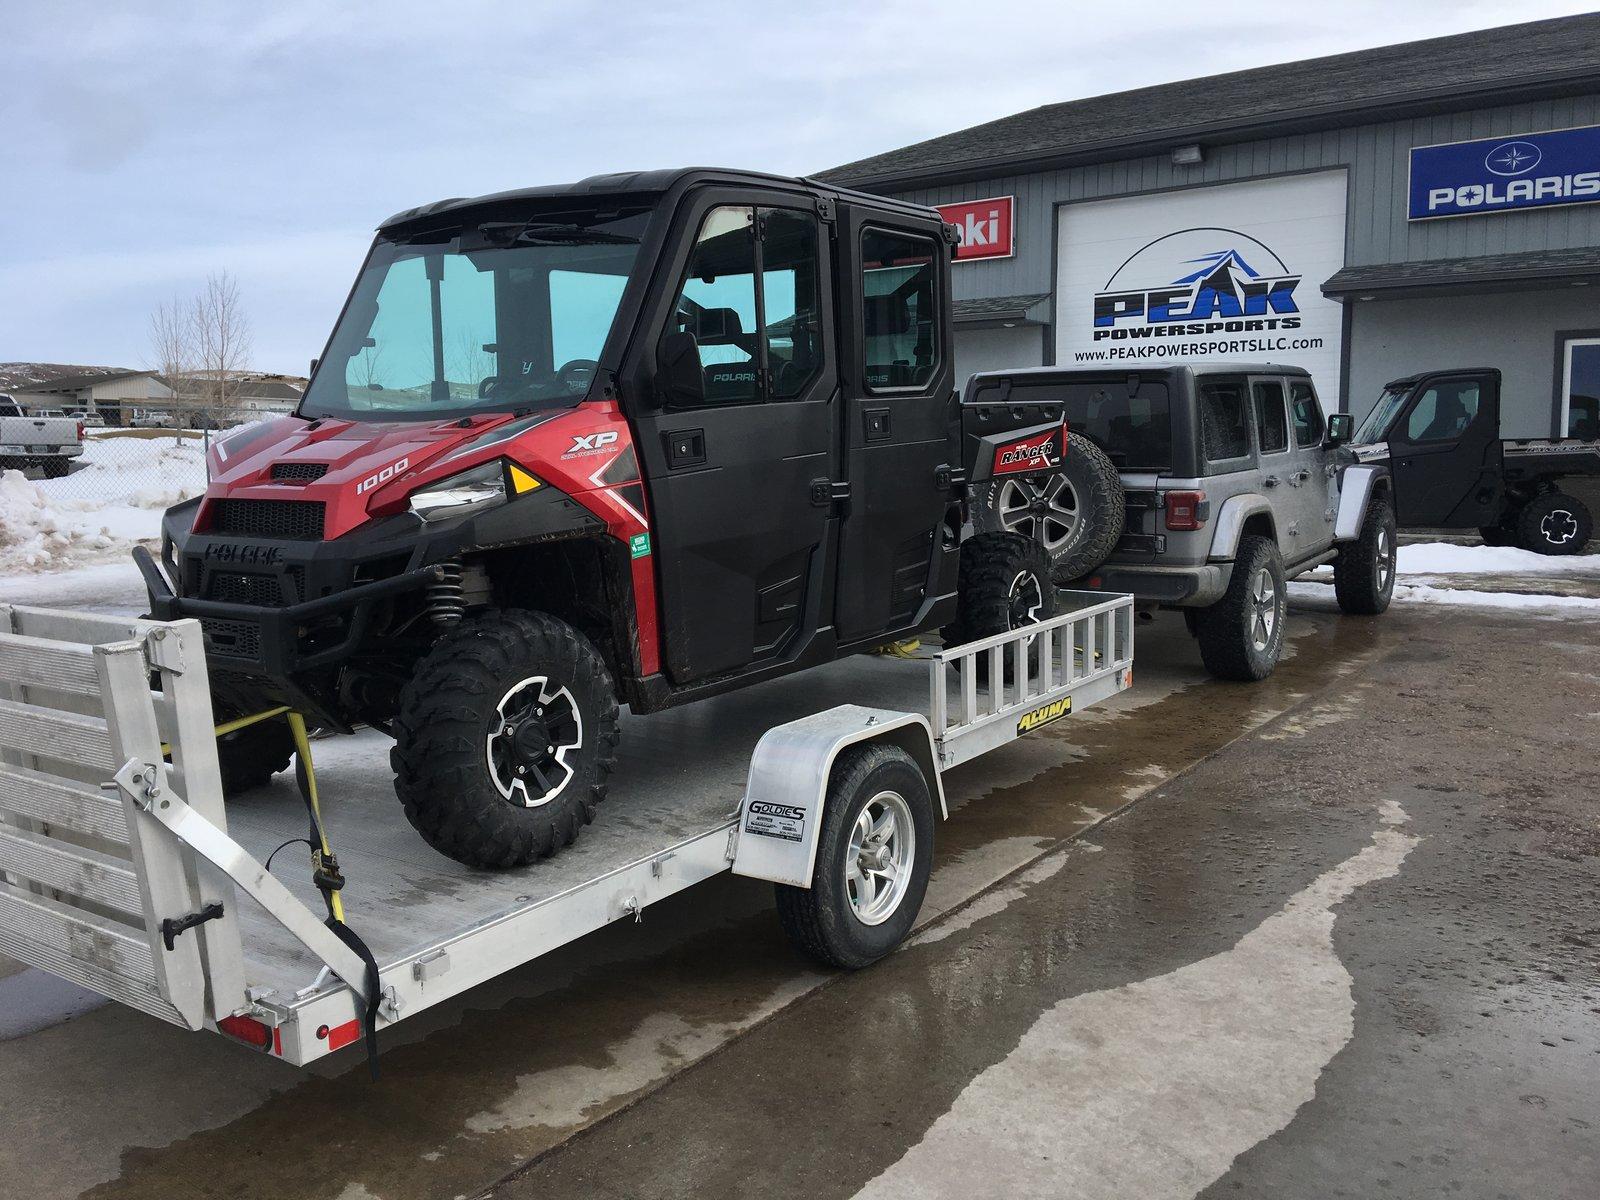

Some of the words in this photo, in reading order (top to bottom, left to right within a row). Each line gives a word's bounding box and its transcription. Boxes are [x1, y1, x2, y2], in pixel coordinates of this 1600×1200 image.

[1429, 172, 1600, 210] POLARIS
[1093, 262, 1302, 327] PEAK
[1093, 317, 1302, 341] POWERSPORTS
[1075, 337, 1323, 361] www.PEAKPOWERSPORTSLLC.com
[567, 431, 619, 454] XP
[1000, 442, 1053, 465] RANGER
[1028, 457, 1041, 466] XP
[356, 457, 409, 495] 1000
[1018, 695, 1071, 730] ALUMA
